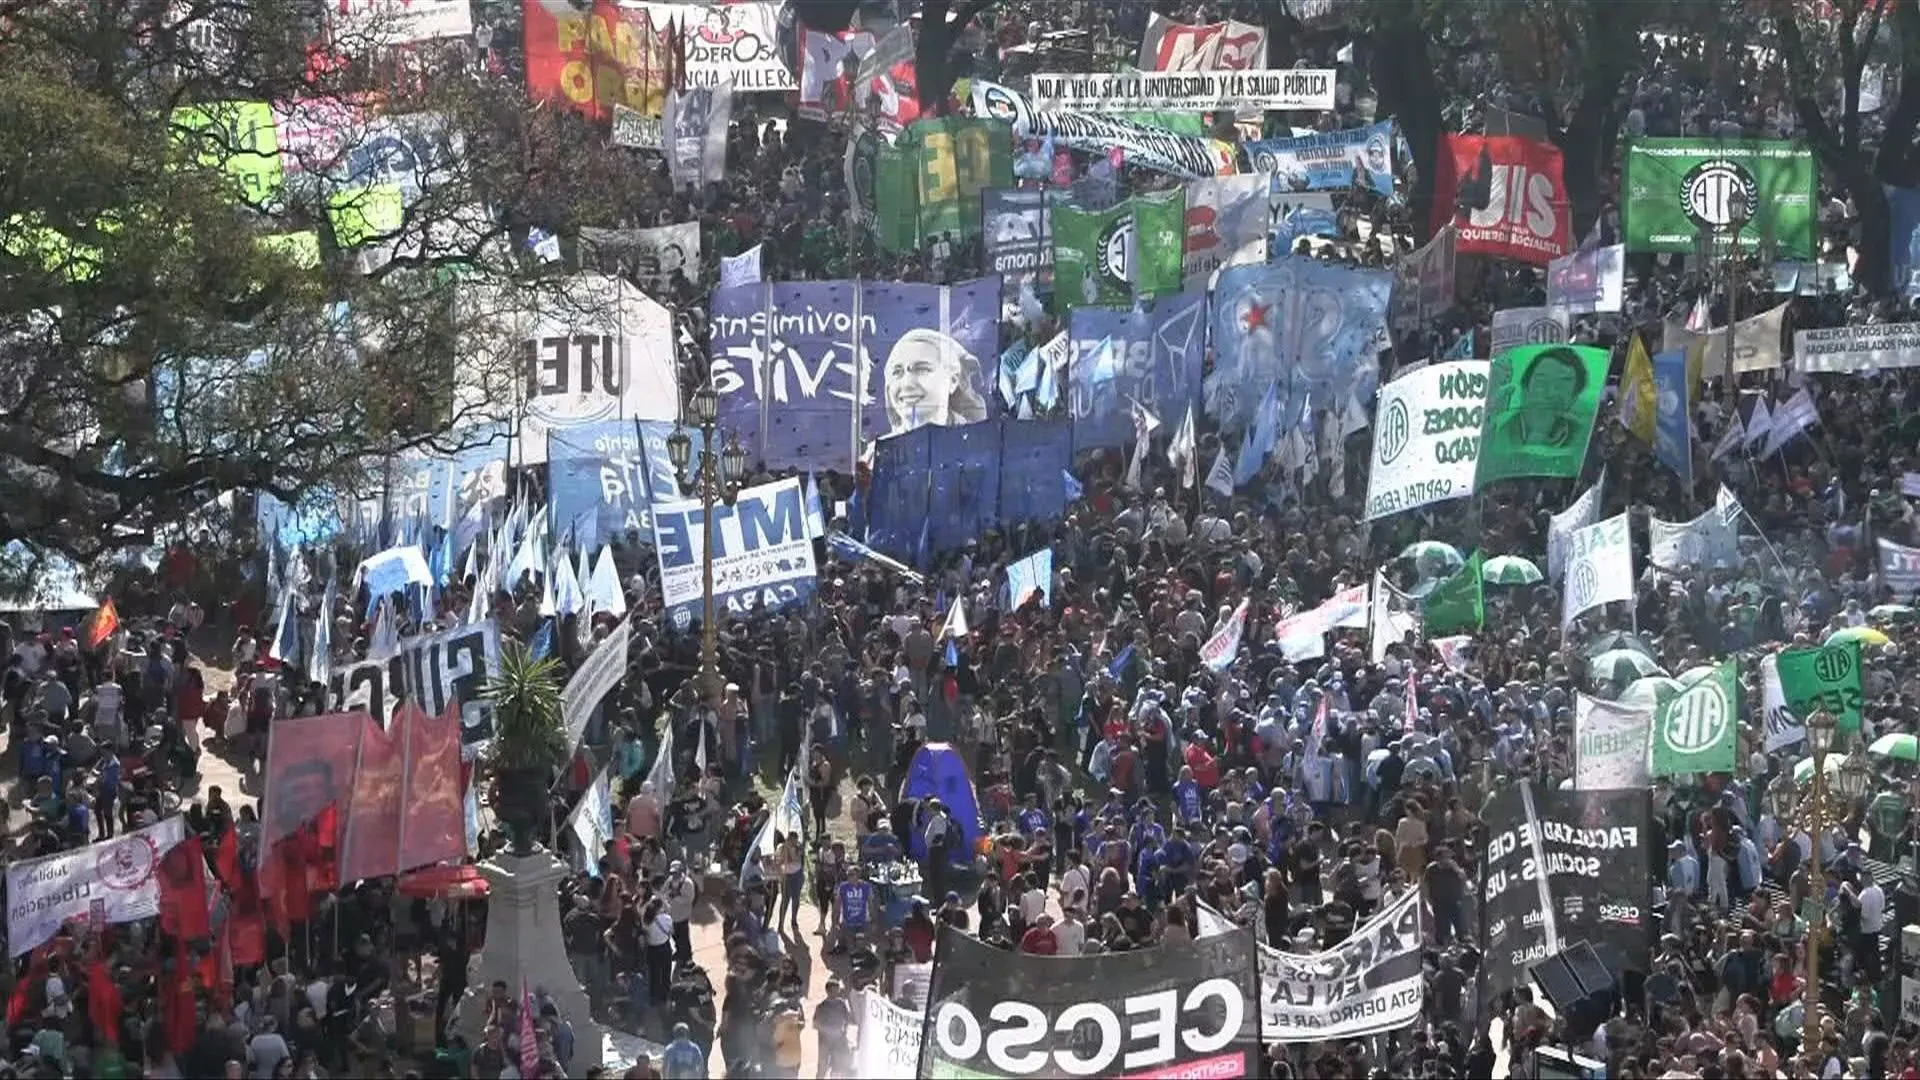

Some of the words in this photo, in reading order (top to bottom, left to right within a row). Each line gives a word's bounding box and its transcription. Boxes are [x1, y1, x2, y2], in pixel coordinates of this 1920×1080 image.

[1037, 79, 1052, 98] NO
[1055, 79, 1067, 98] AL
[1127, 78, 1141, 97] LA
[1145, 76, 1214, 97] UNIVERSIDAD
[1219, 76, 1228, 96] Y
[1231, 76, 1244, 96] LA
[1247, 75, 1280, 96] SALUD
